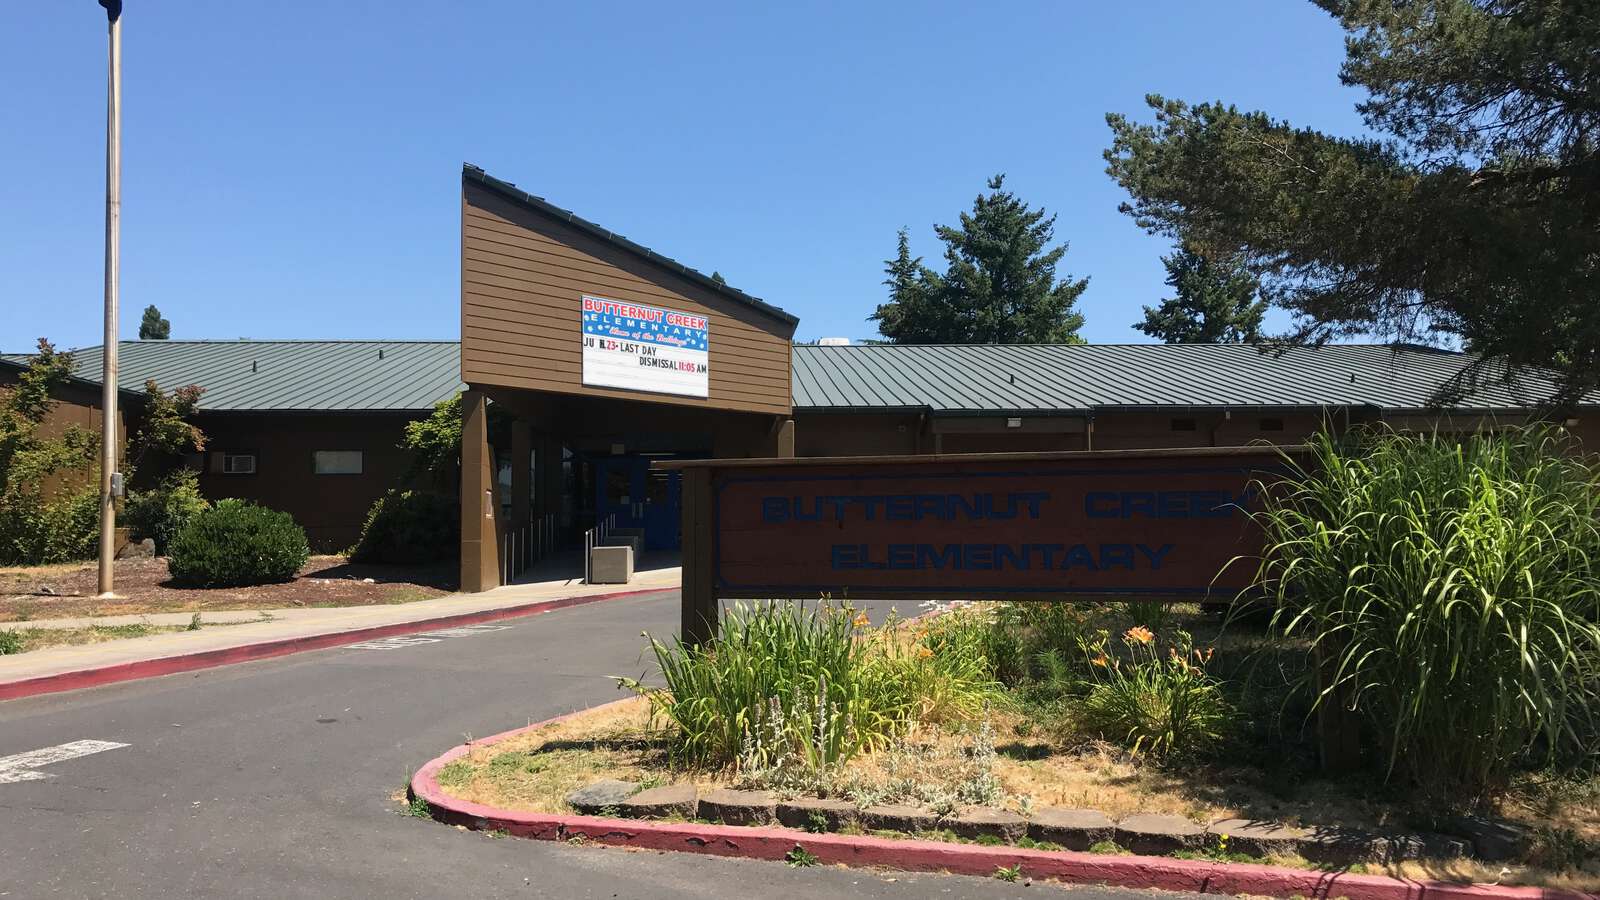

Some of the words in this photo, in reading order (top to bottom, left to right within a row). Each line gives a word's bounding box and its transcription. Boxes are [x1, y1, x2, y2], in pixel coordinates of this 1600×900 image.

[583, 298, 664, 322] BUTTERNUT
[666, 313, 707, 330] CREEK
[590, 313, 703, 339] ELEMENTARY
[620, 342, 639, 354] LAST
[641, 345, 657, 356] DAY
[639, 356, 678, 370] DISMISSAL
[696, 364, 707, 374] AM
[761, 491, 1050, 523] BUTTERNUT
[831, 542, 1174, 572] ELEMENTARY
